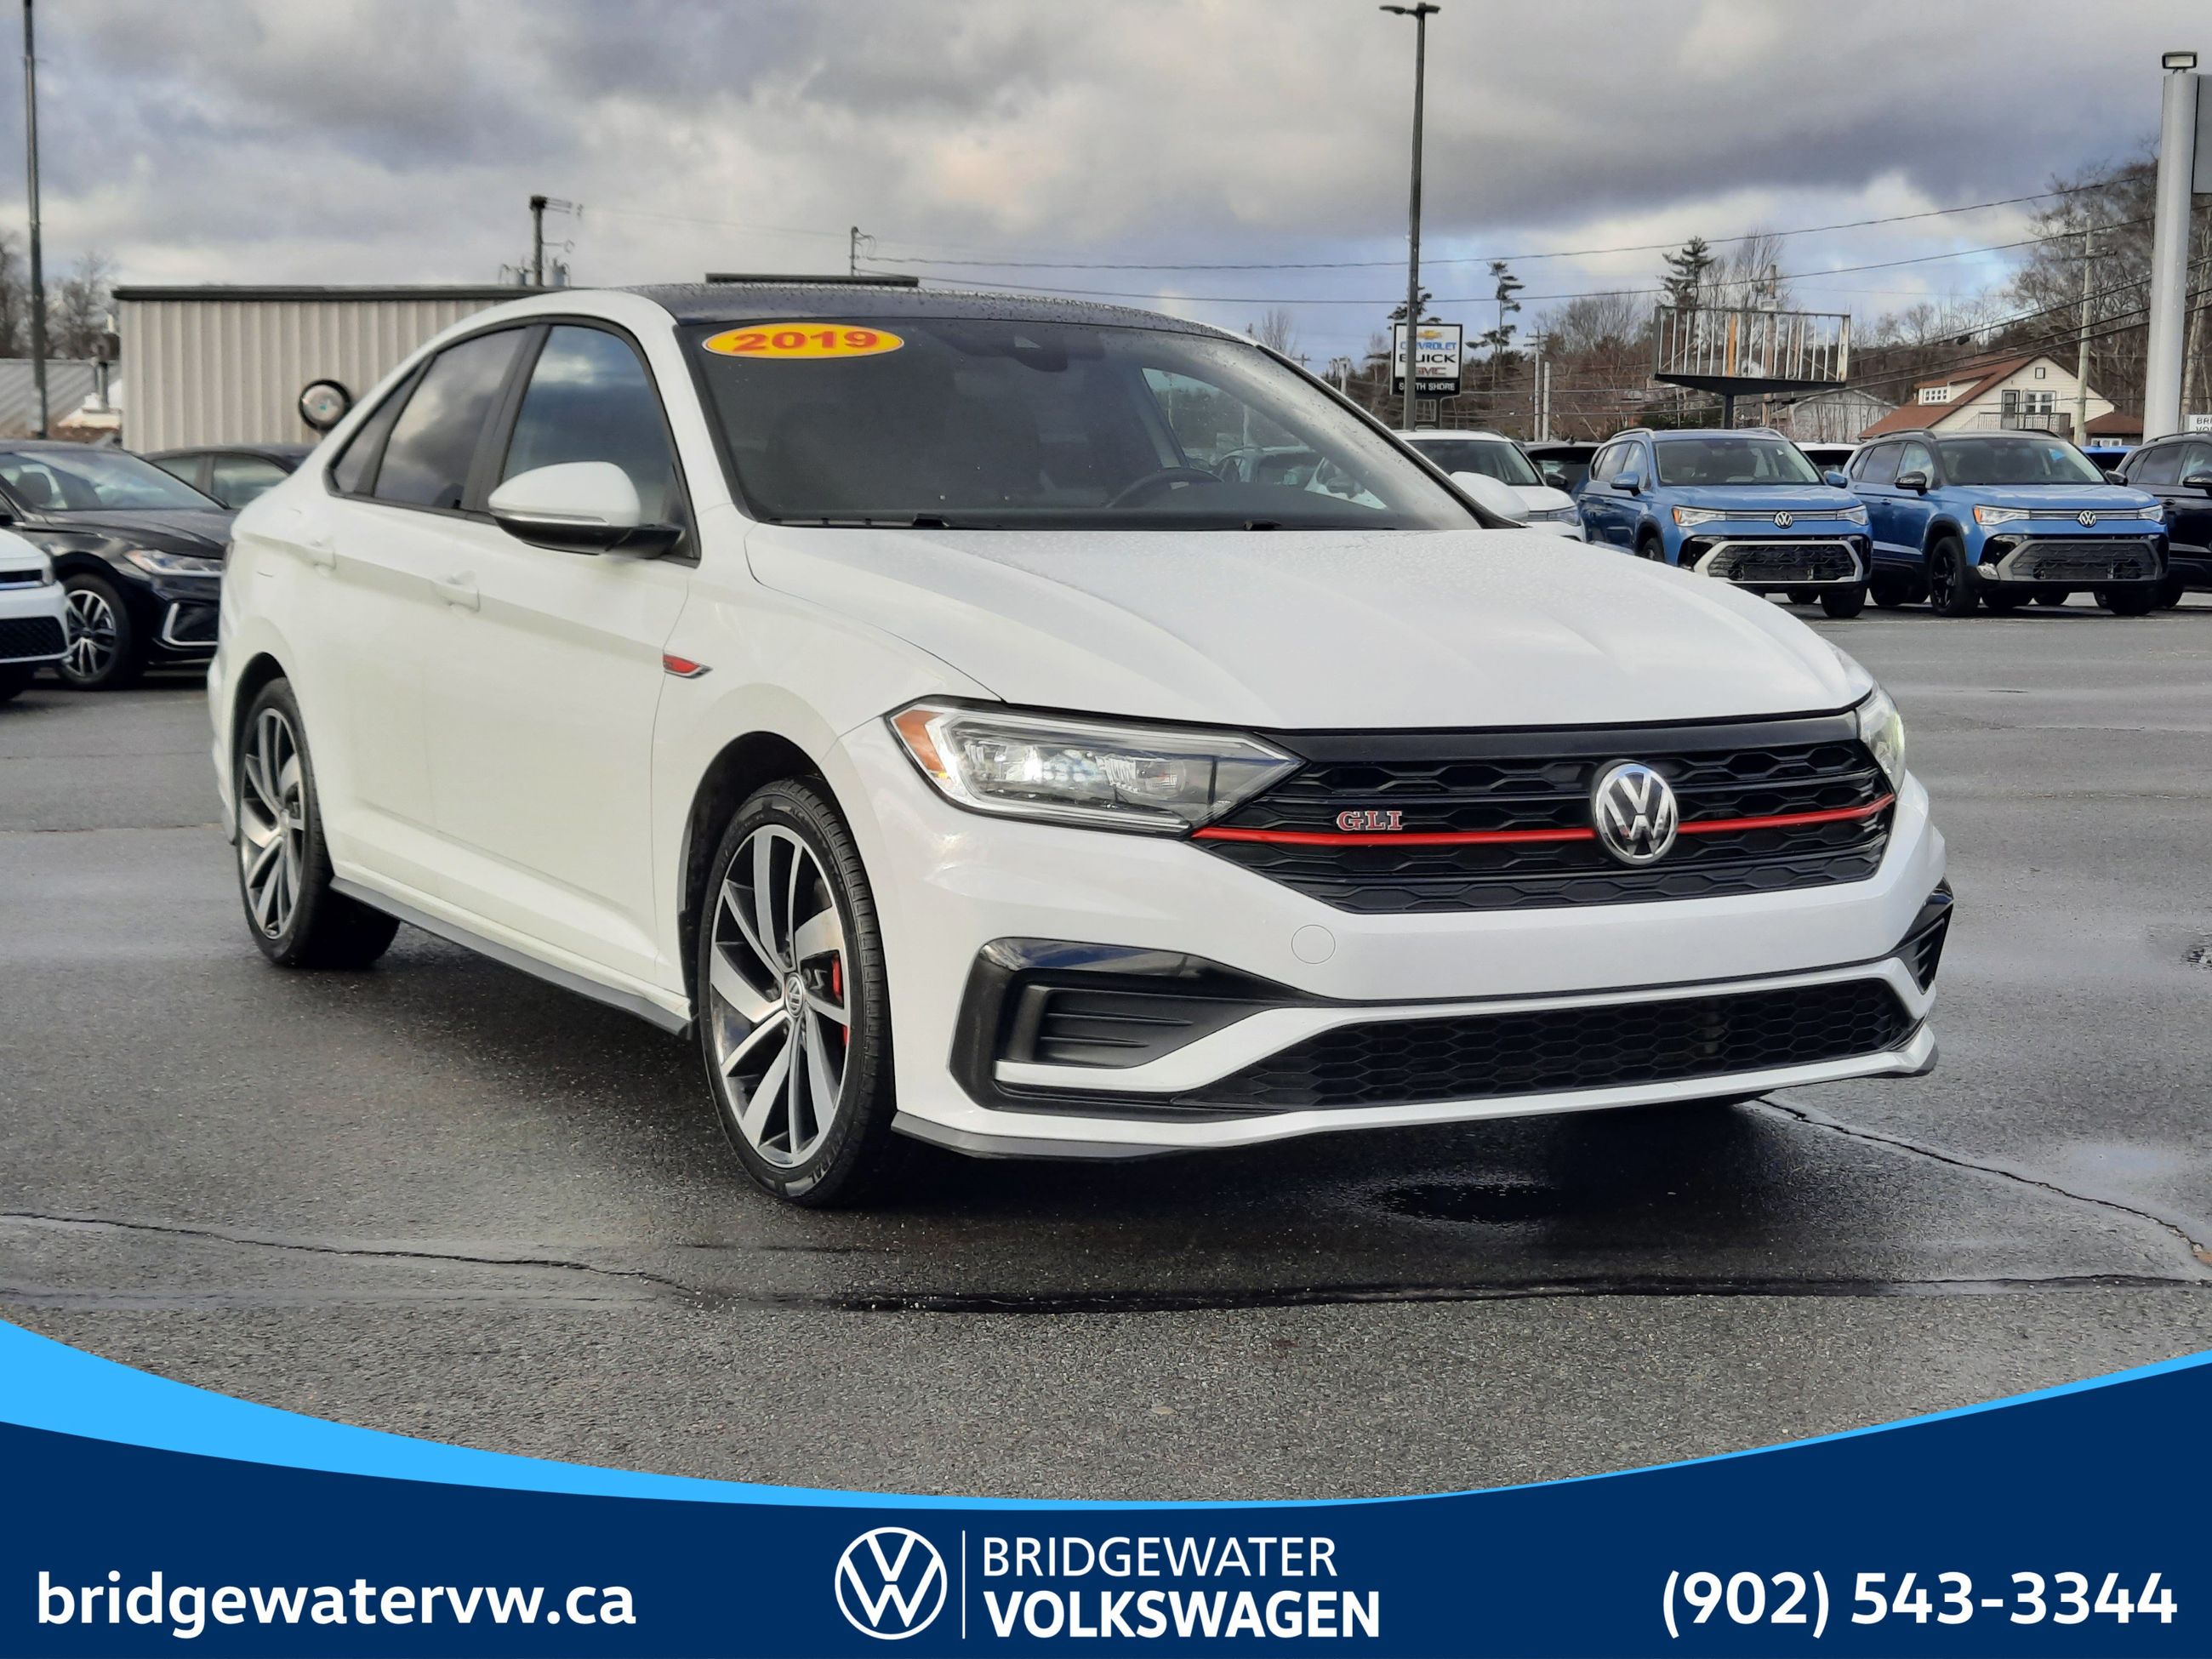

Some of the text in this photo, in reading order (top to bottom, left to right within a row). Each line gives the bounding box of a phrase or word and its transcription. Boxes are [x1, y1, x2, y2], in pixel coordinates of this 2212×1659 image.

[733, 331, 878, 351] 2019
[1400, 341, 1457, 351] CVROLET
[1399, 382, 1455, 391] STH SHORE
[1336, 810, 1404, 831] GLI
[1595, 763, 1678, 864] VW
